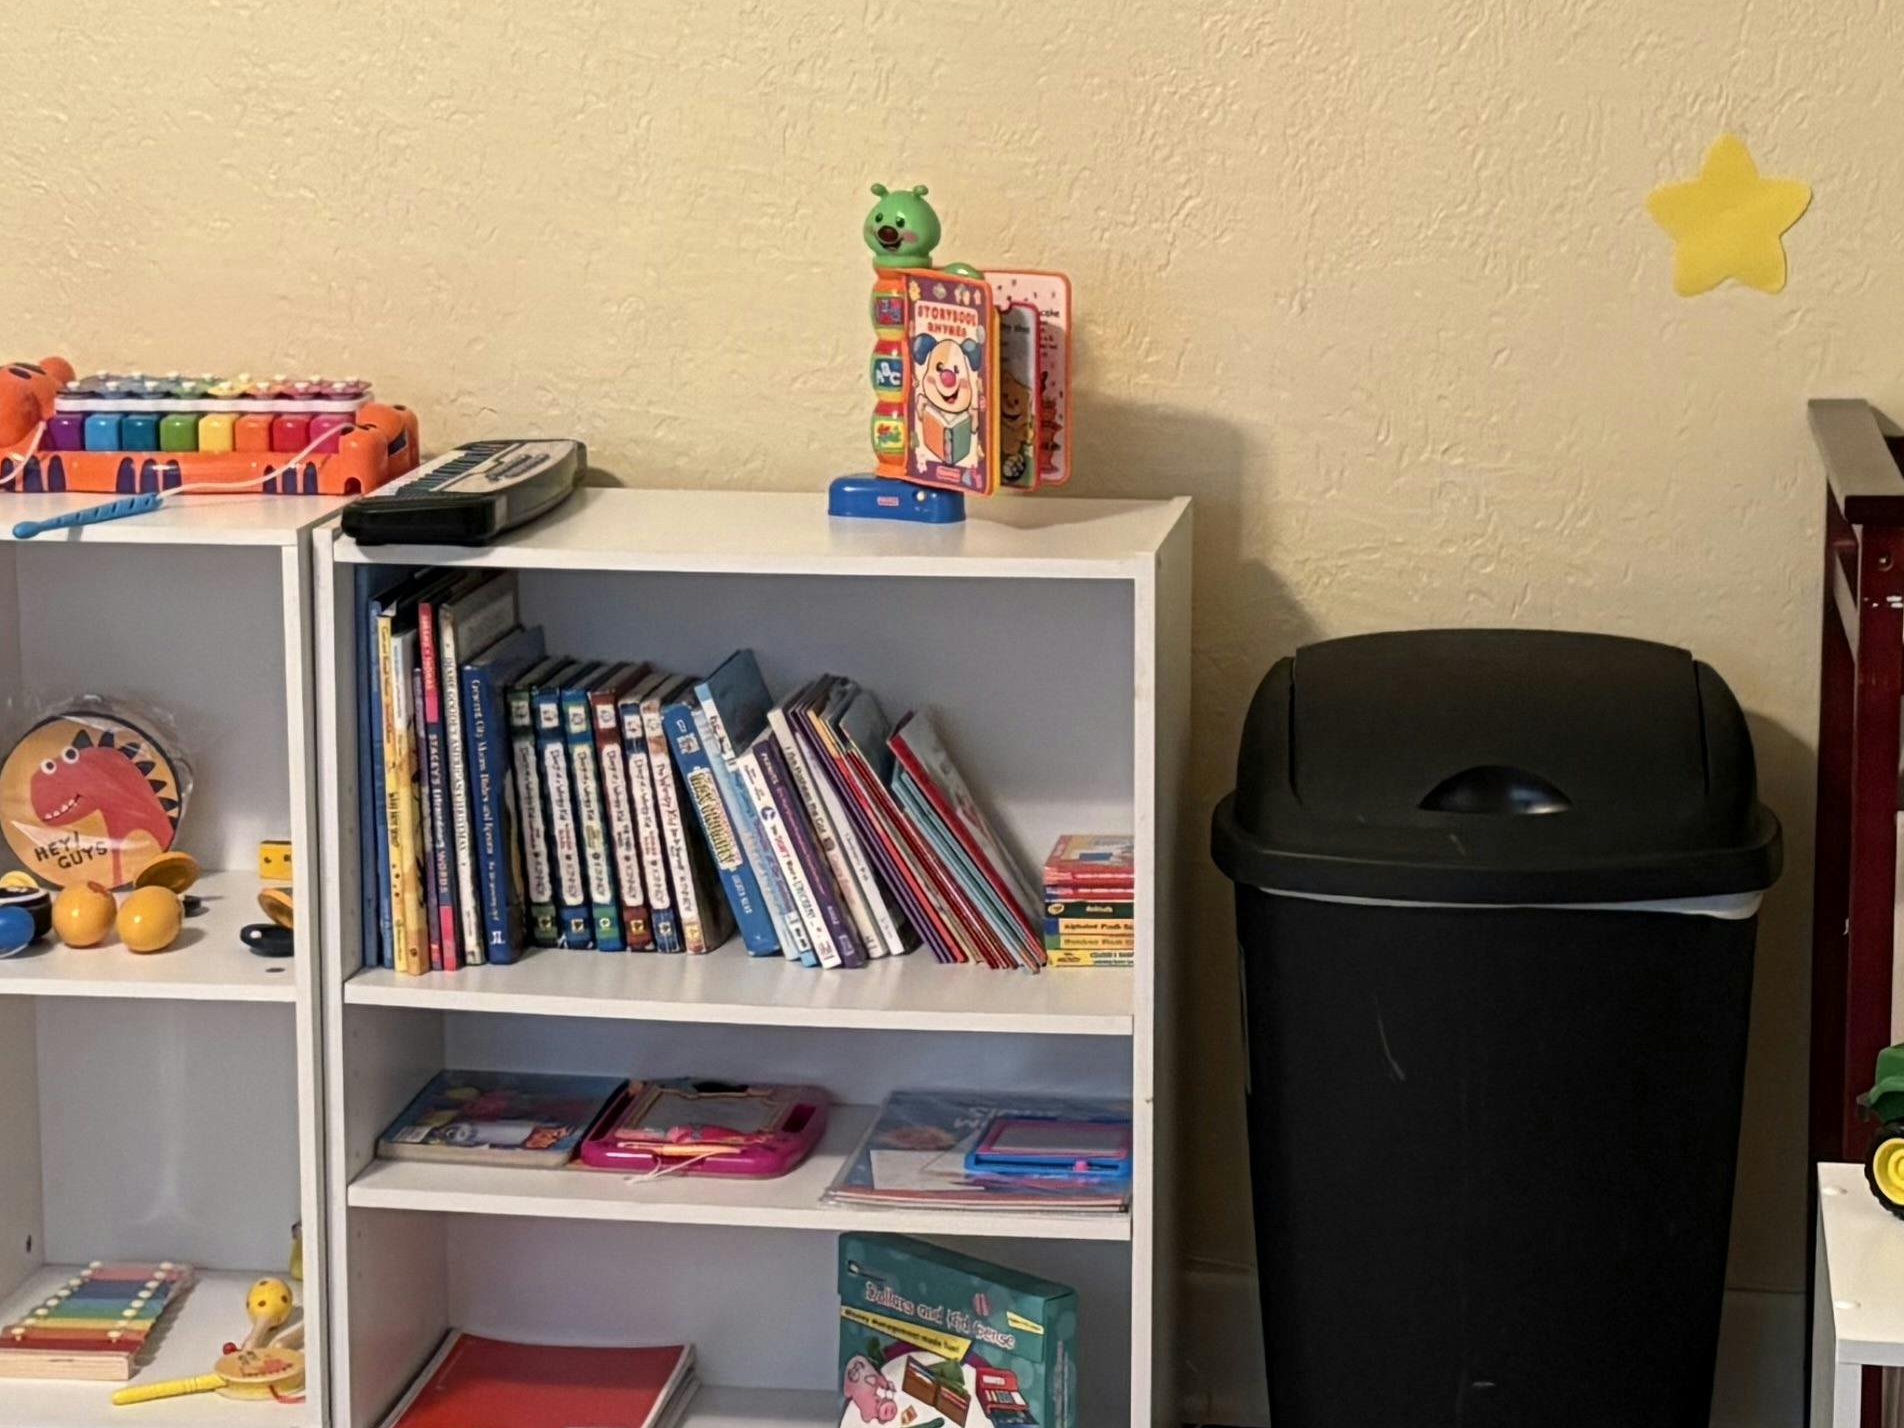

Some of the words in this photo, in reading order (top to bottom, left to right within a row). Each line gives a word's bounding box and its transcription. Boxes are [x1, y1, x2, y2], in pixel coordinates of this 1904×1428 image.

[876, 362, 902, 385] ABC
[34, 831, 80, 862] HEY!
[58, 841, 108, 869] GUYS
[865, 1281, 915, 1316] Dollars
[917, 1303, 945, 1324] and
[972, 1320, 1016, 1350] Sense
